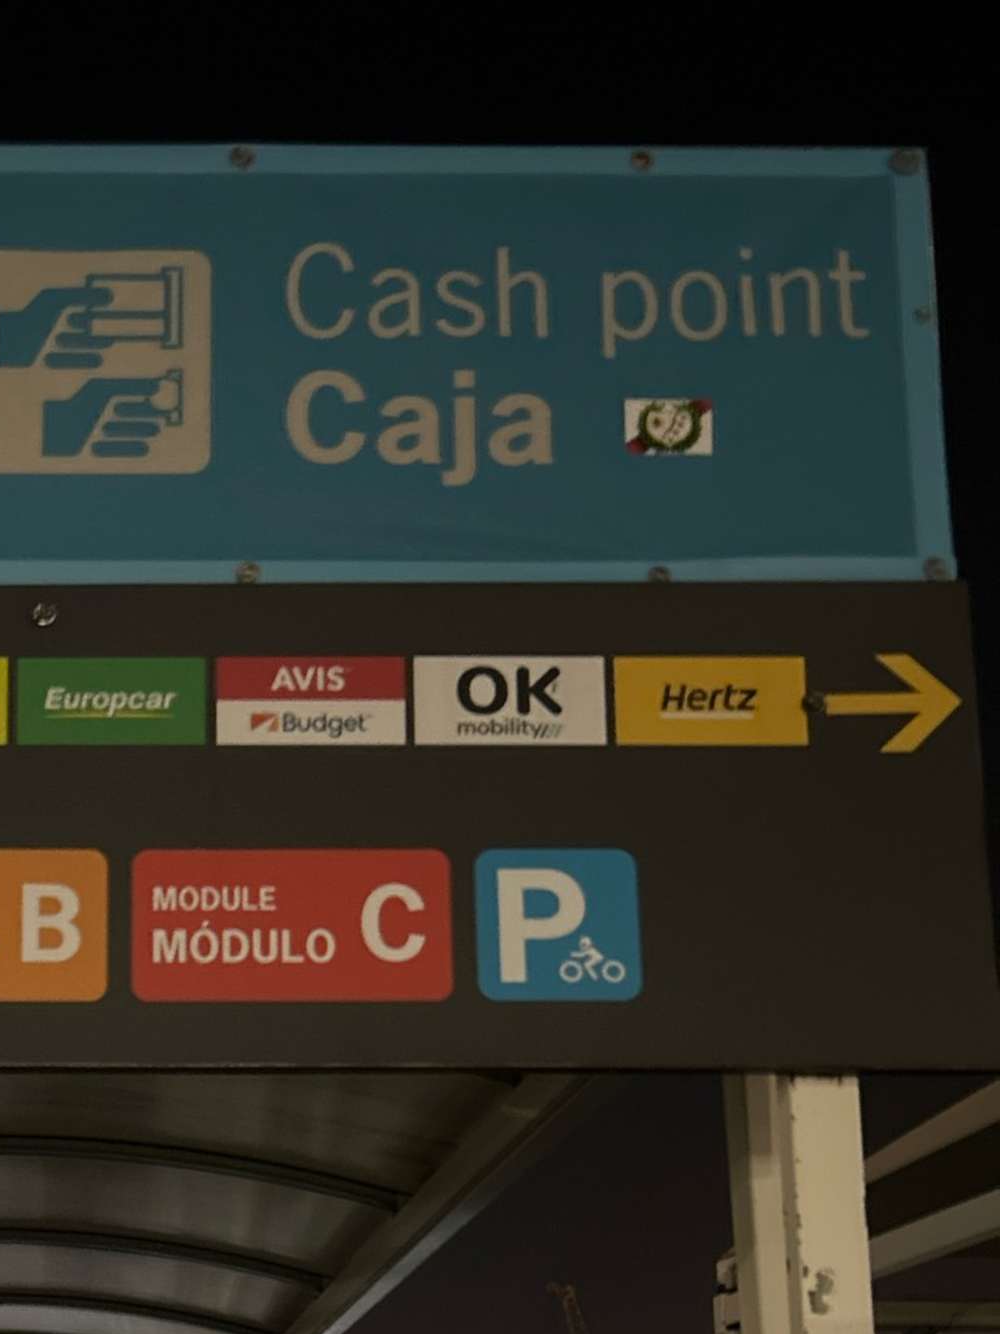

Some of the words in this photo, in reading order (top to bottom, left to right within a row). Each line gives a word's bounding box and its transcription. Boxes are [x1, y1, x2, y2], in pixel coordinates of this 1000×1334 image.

[285, 242, 549, 341] Cash
[601, 247, 870, 359] point
[285, 369, 554, 487] Caja
[44, 686, 176, 718] Europcar
[270, 665, 346, 693] AVIS
[456, 666, 563, 715] OK
[660, 683, 758, 714] Hertz
[281, 712, 369, 738] Budget
[152, 885, 277, 912] MODULE
[21, 882, 81, 963] B
[152, 920, 336, 964] MÓDULO
[360, 882, 426, 963] C
[496, 868, 586, 984] P
